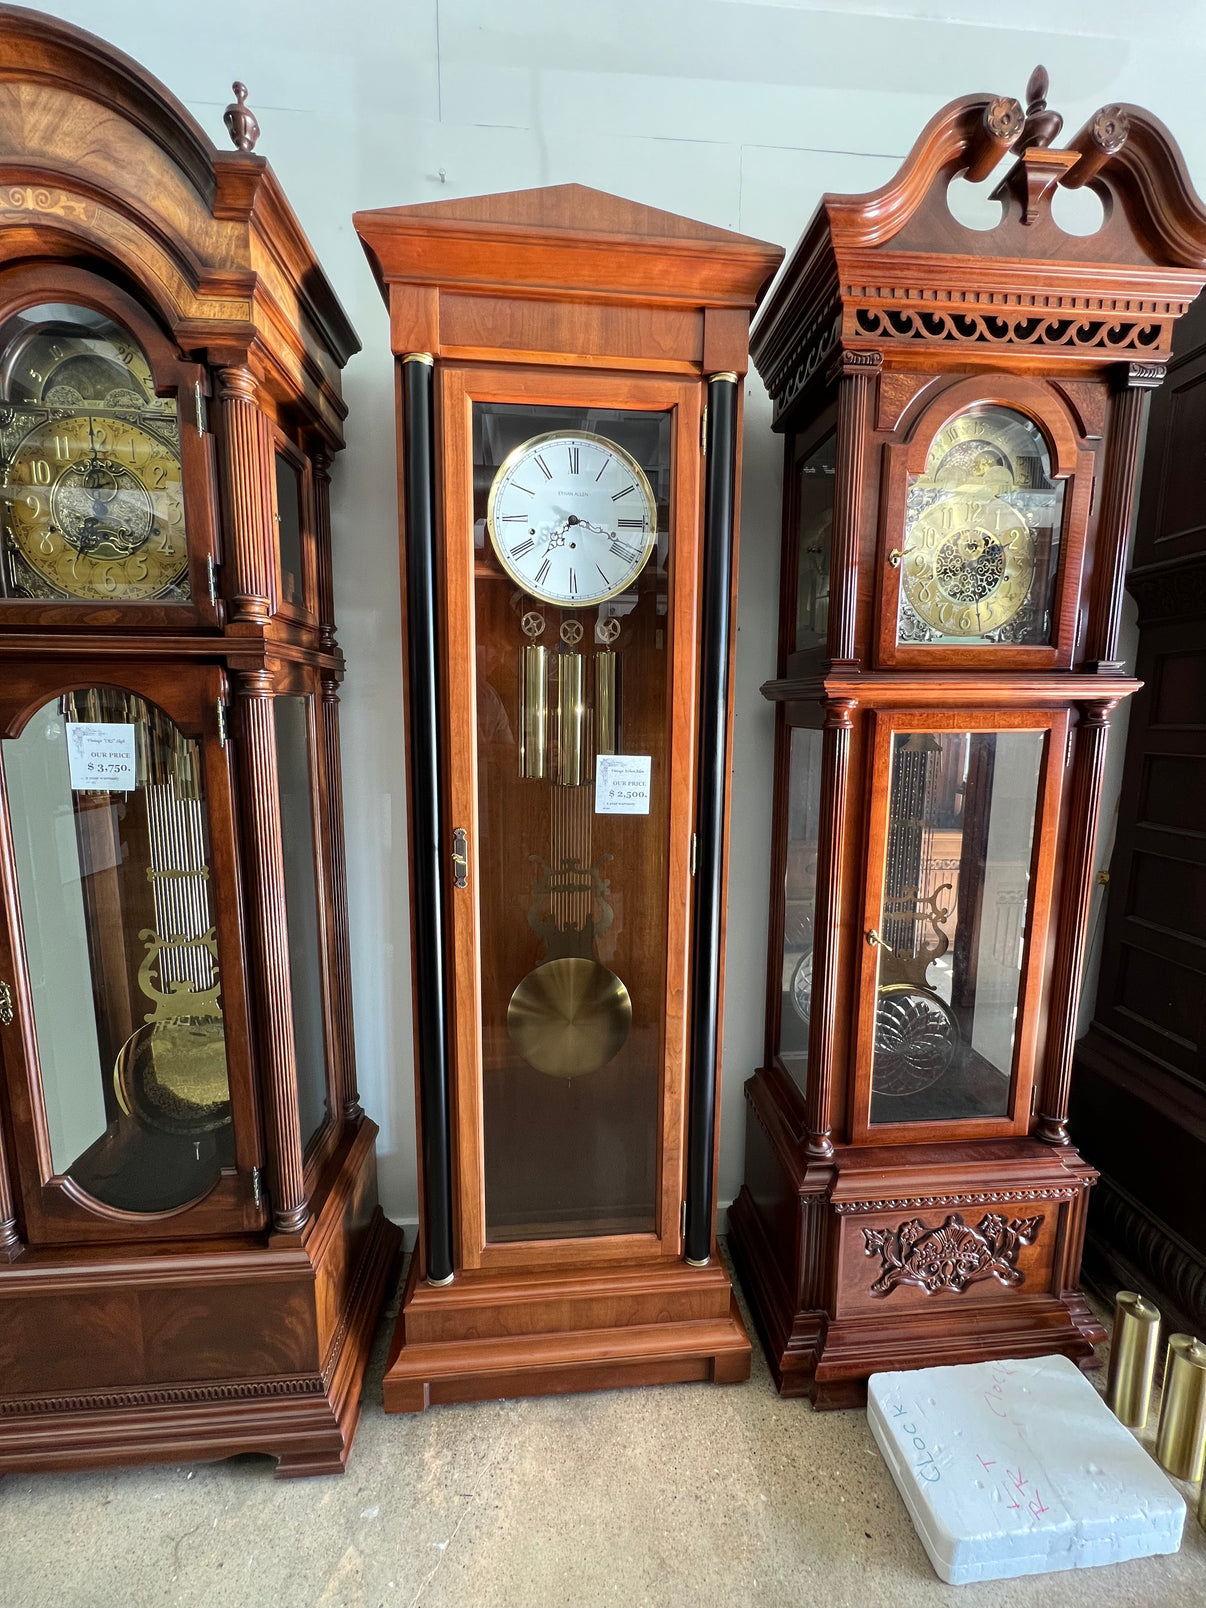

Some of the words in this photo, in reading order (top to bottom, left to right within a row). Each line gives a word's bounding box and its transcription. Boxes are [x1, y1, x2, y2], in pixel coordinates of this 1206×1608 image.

[54, 436, 70, 460] 11
[128, 438, 136, 464] 1
[31, 460, 50, 484] 10
[153, 466, 167, 490] 2
[26, 496, 40, 518] 9
[965, 502, 984, 522] 12
[942, 508, 955, 529] 11
[40, 530, 54, 554] 8
[161, 533, 174, 557] 4
[922, 528, 936, 550] 10
[1009, 529, 1020, 550] 2
[66, 557, 80, 580] 7
[136, 556, 148, 581] 5
[914, 555, 926, 577] 9
[102, 566, 116, 592] 6
[918, 580, 931, 602] 8
[936, 602, 948, 624] 7
[960, 608, 971, 630] 6
[985, 601, 997, 622] 5
[87, 762, 94, 771] $
[97, 764, 131, 773] 3,750.
[609, 789, 614, 798] $
[893, 1404, 941, 1482] CLOCK
